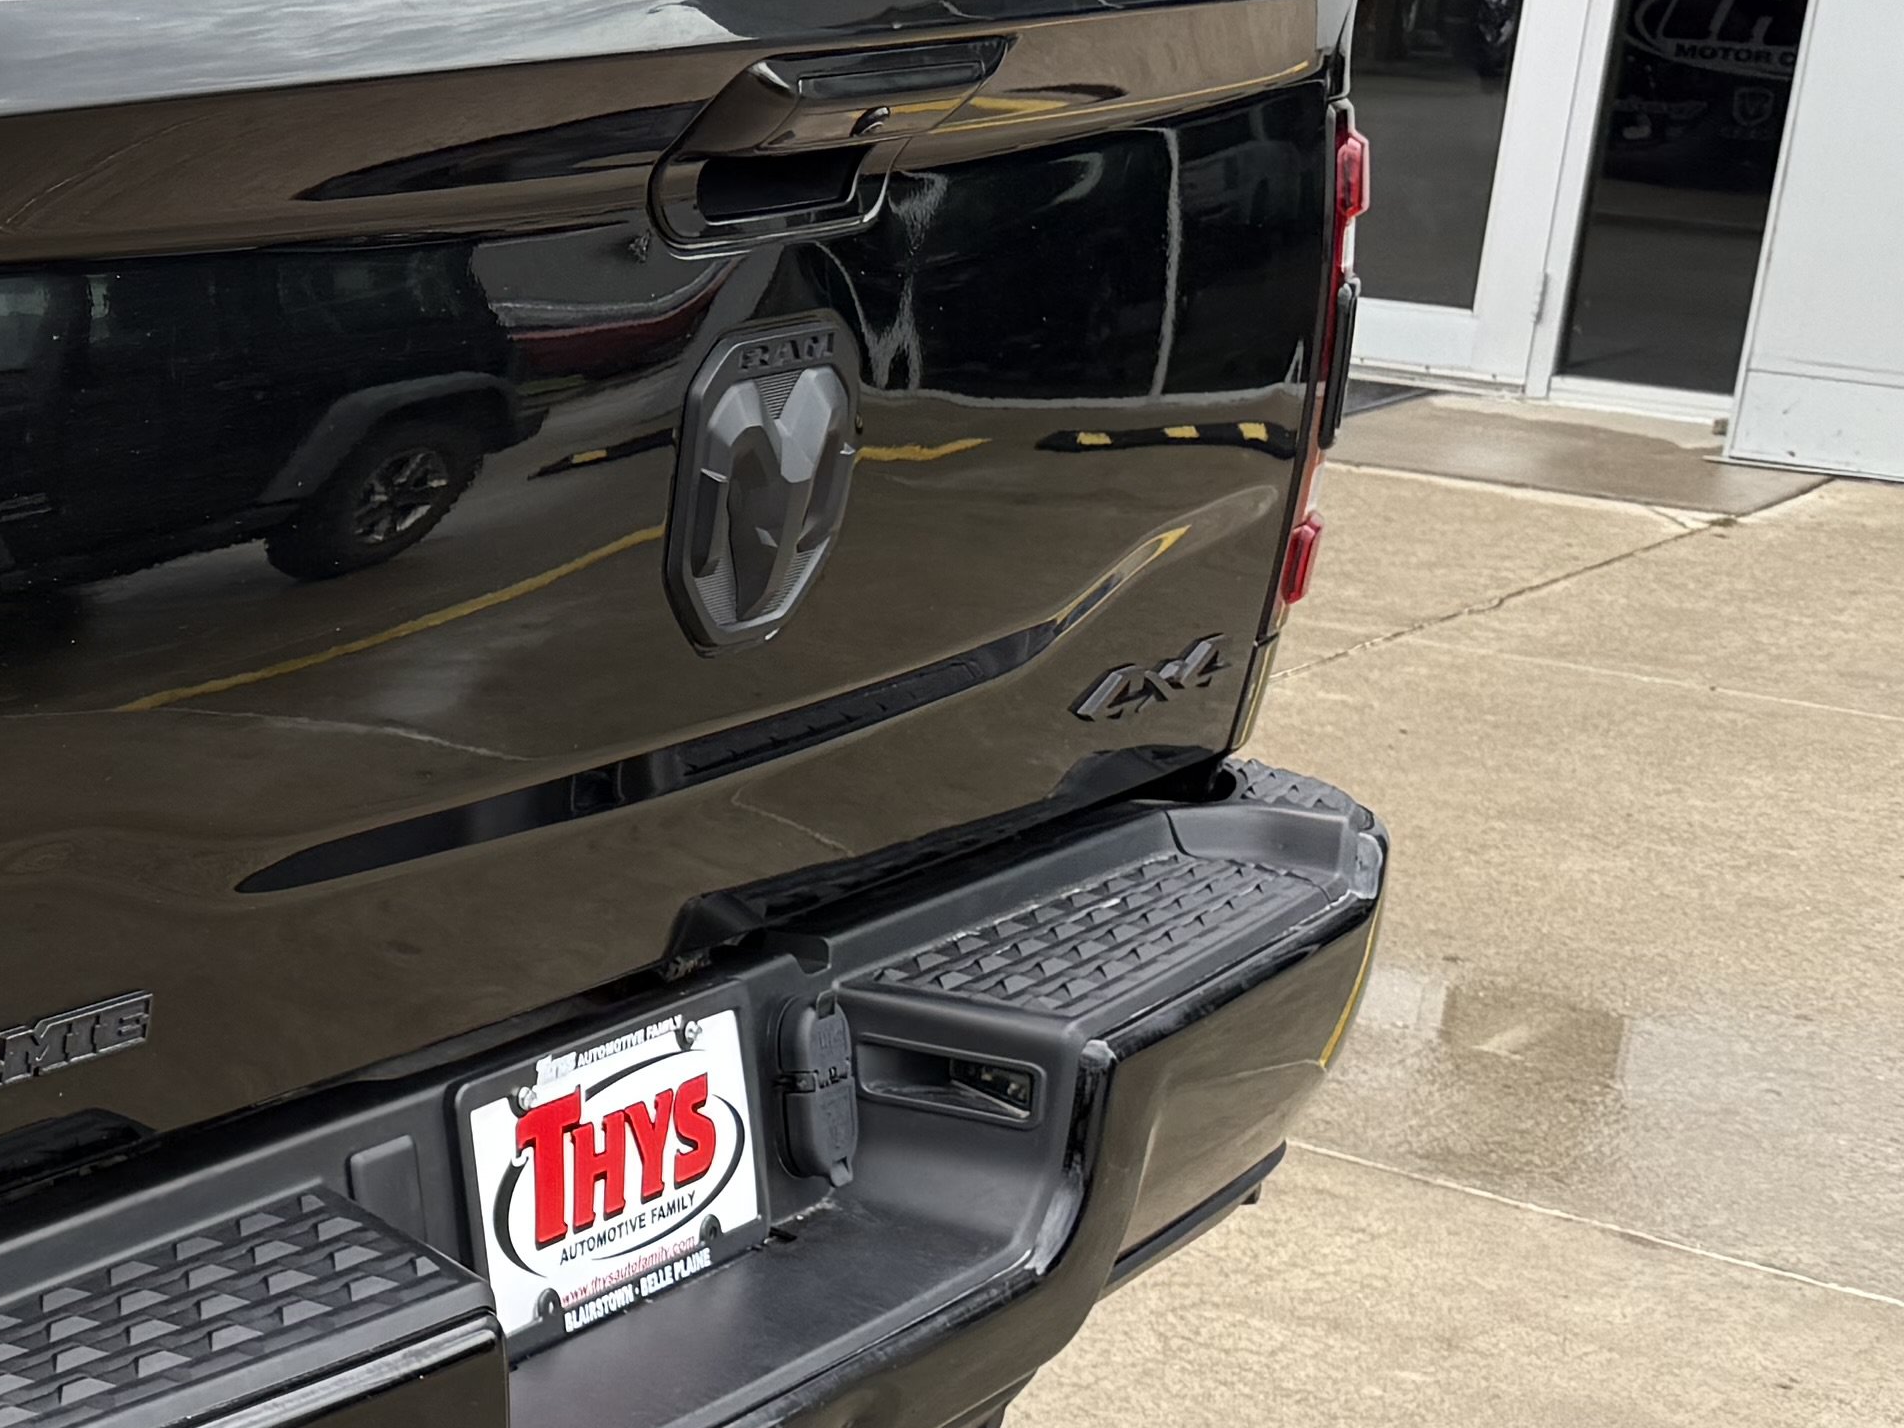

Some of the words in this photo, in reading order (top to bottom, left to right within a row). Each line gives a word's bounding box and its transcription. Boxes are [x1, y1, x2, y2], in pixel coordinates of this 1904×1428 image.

[737, 332, 835, 370] RAM
[578, 1029, 645, 1068] AUTOMOTIVE
[516, 1072, 716, 1250] THYS
[560, 1213, 646, 1266] AUTOMOTIVE
[651, 1190, 695, 1224] FAMILY
[562, 1236, 696, 1308] www.thysautofamily.com
[564, 1284, 634, 1333] BLAIRSTOWN
[640, 1264, 674, 1297] BELLE
[674, 1247, 713, 1281] PLAINE
